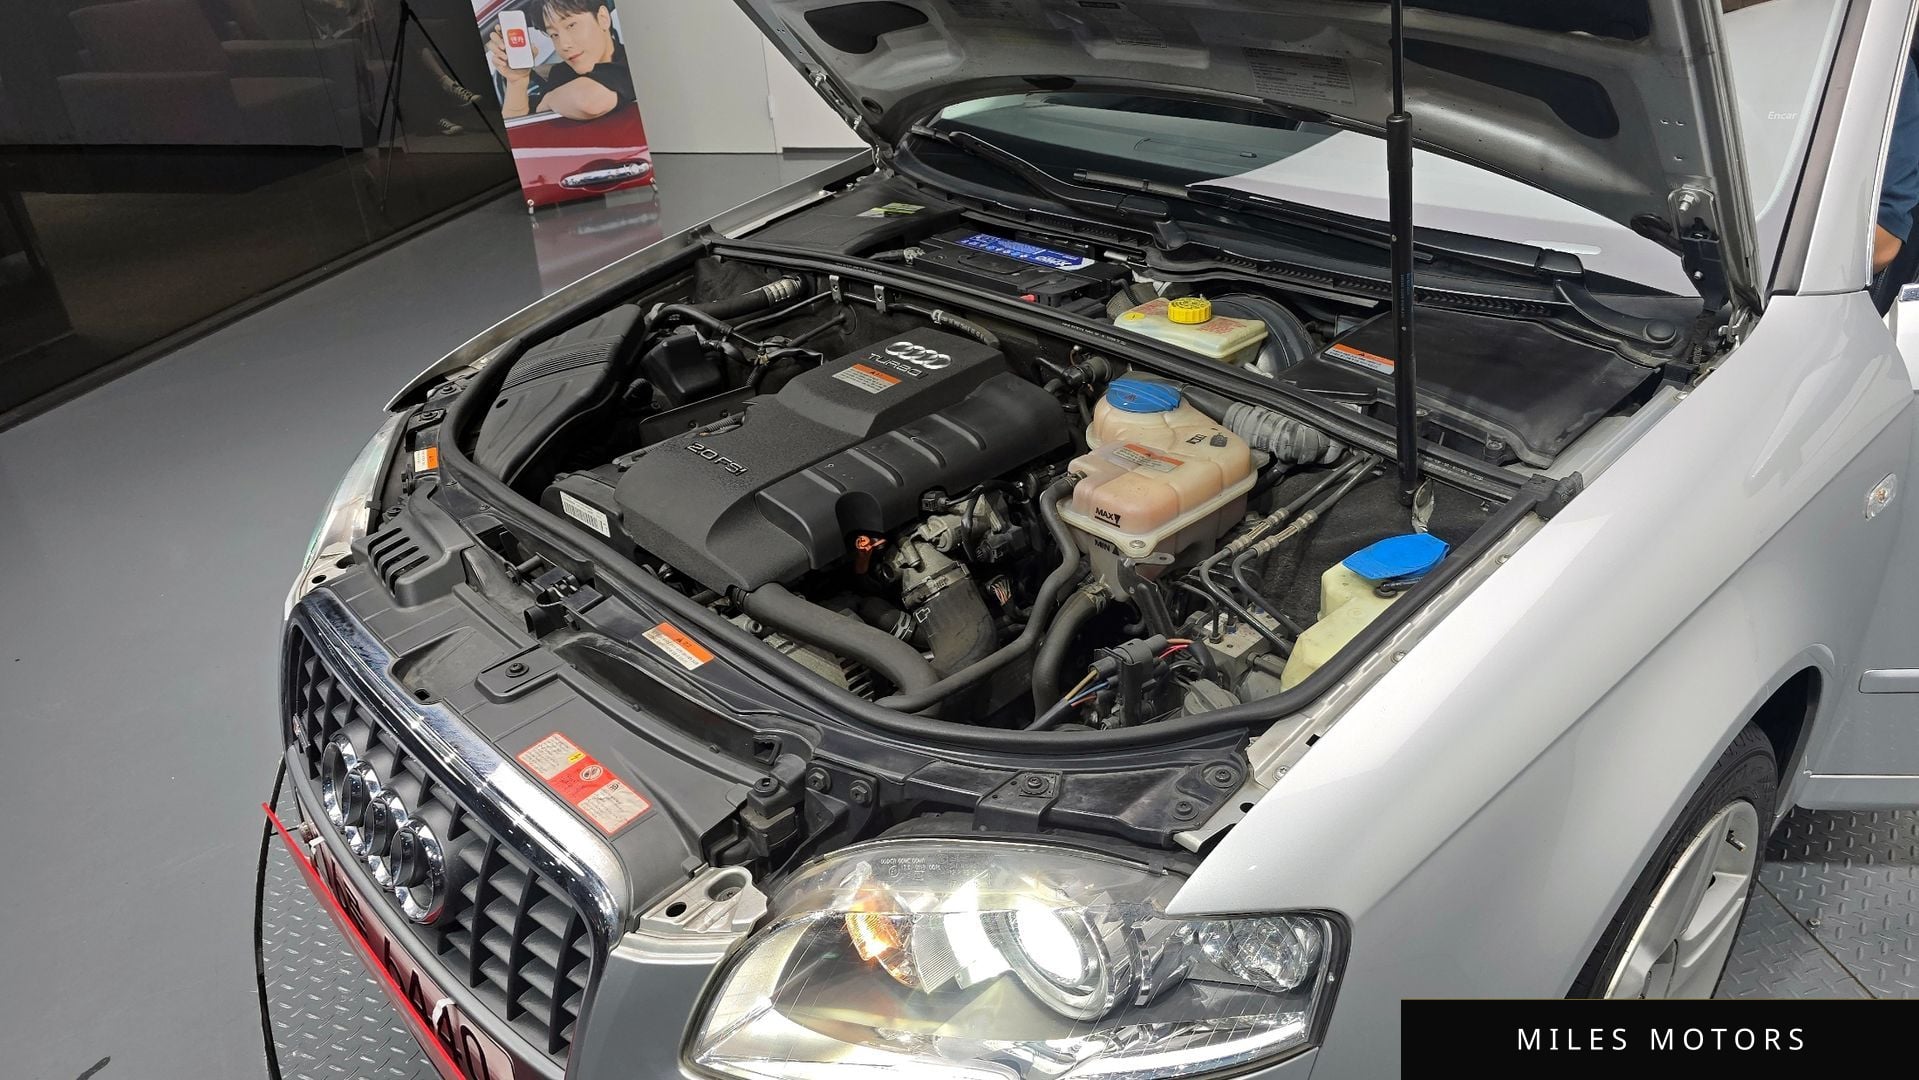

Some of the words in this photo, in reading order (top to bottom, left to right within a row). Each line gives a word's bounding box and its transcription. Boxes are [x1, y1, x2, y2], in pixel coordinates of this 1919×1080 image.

[868, 353, 923, 377] TURBO
[714, 456, 748, 476] FSI
[1095, 507, 1114, 521] MAX
[1094, 539, 1110, 552] MIN
